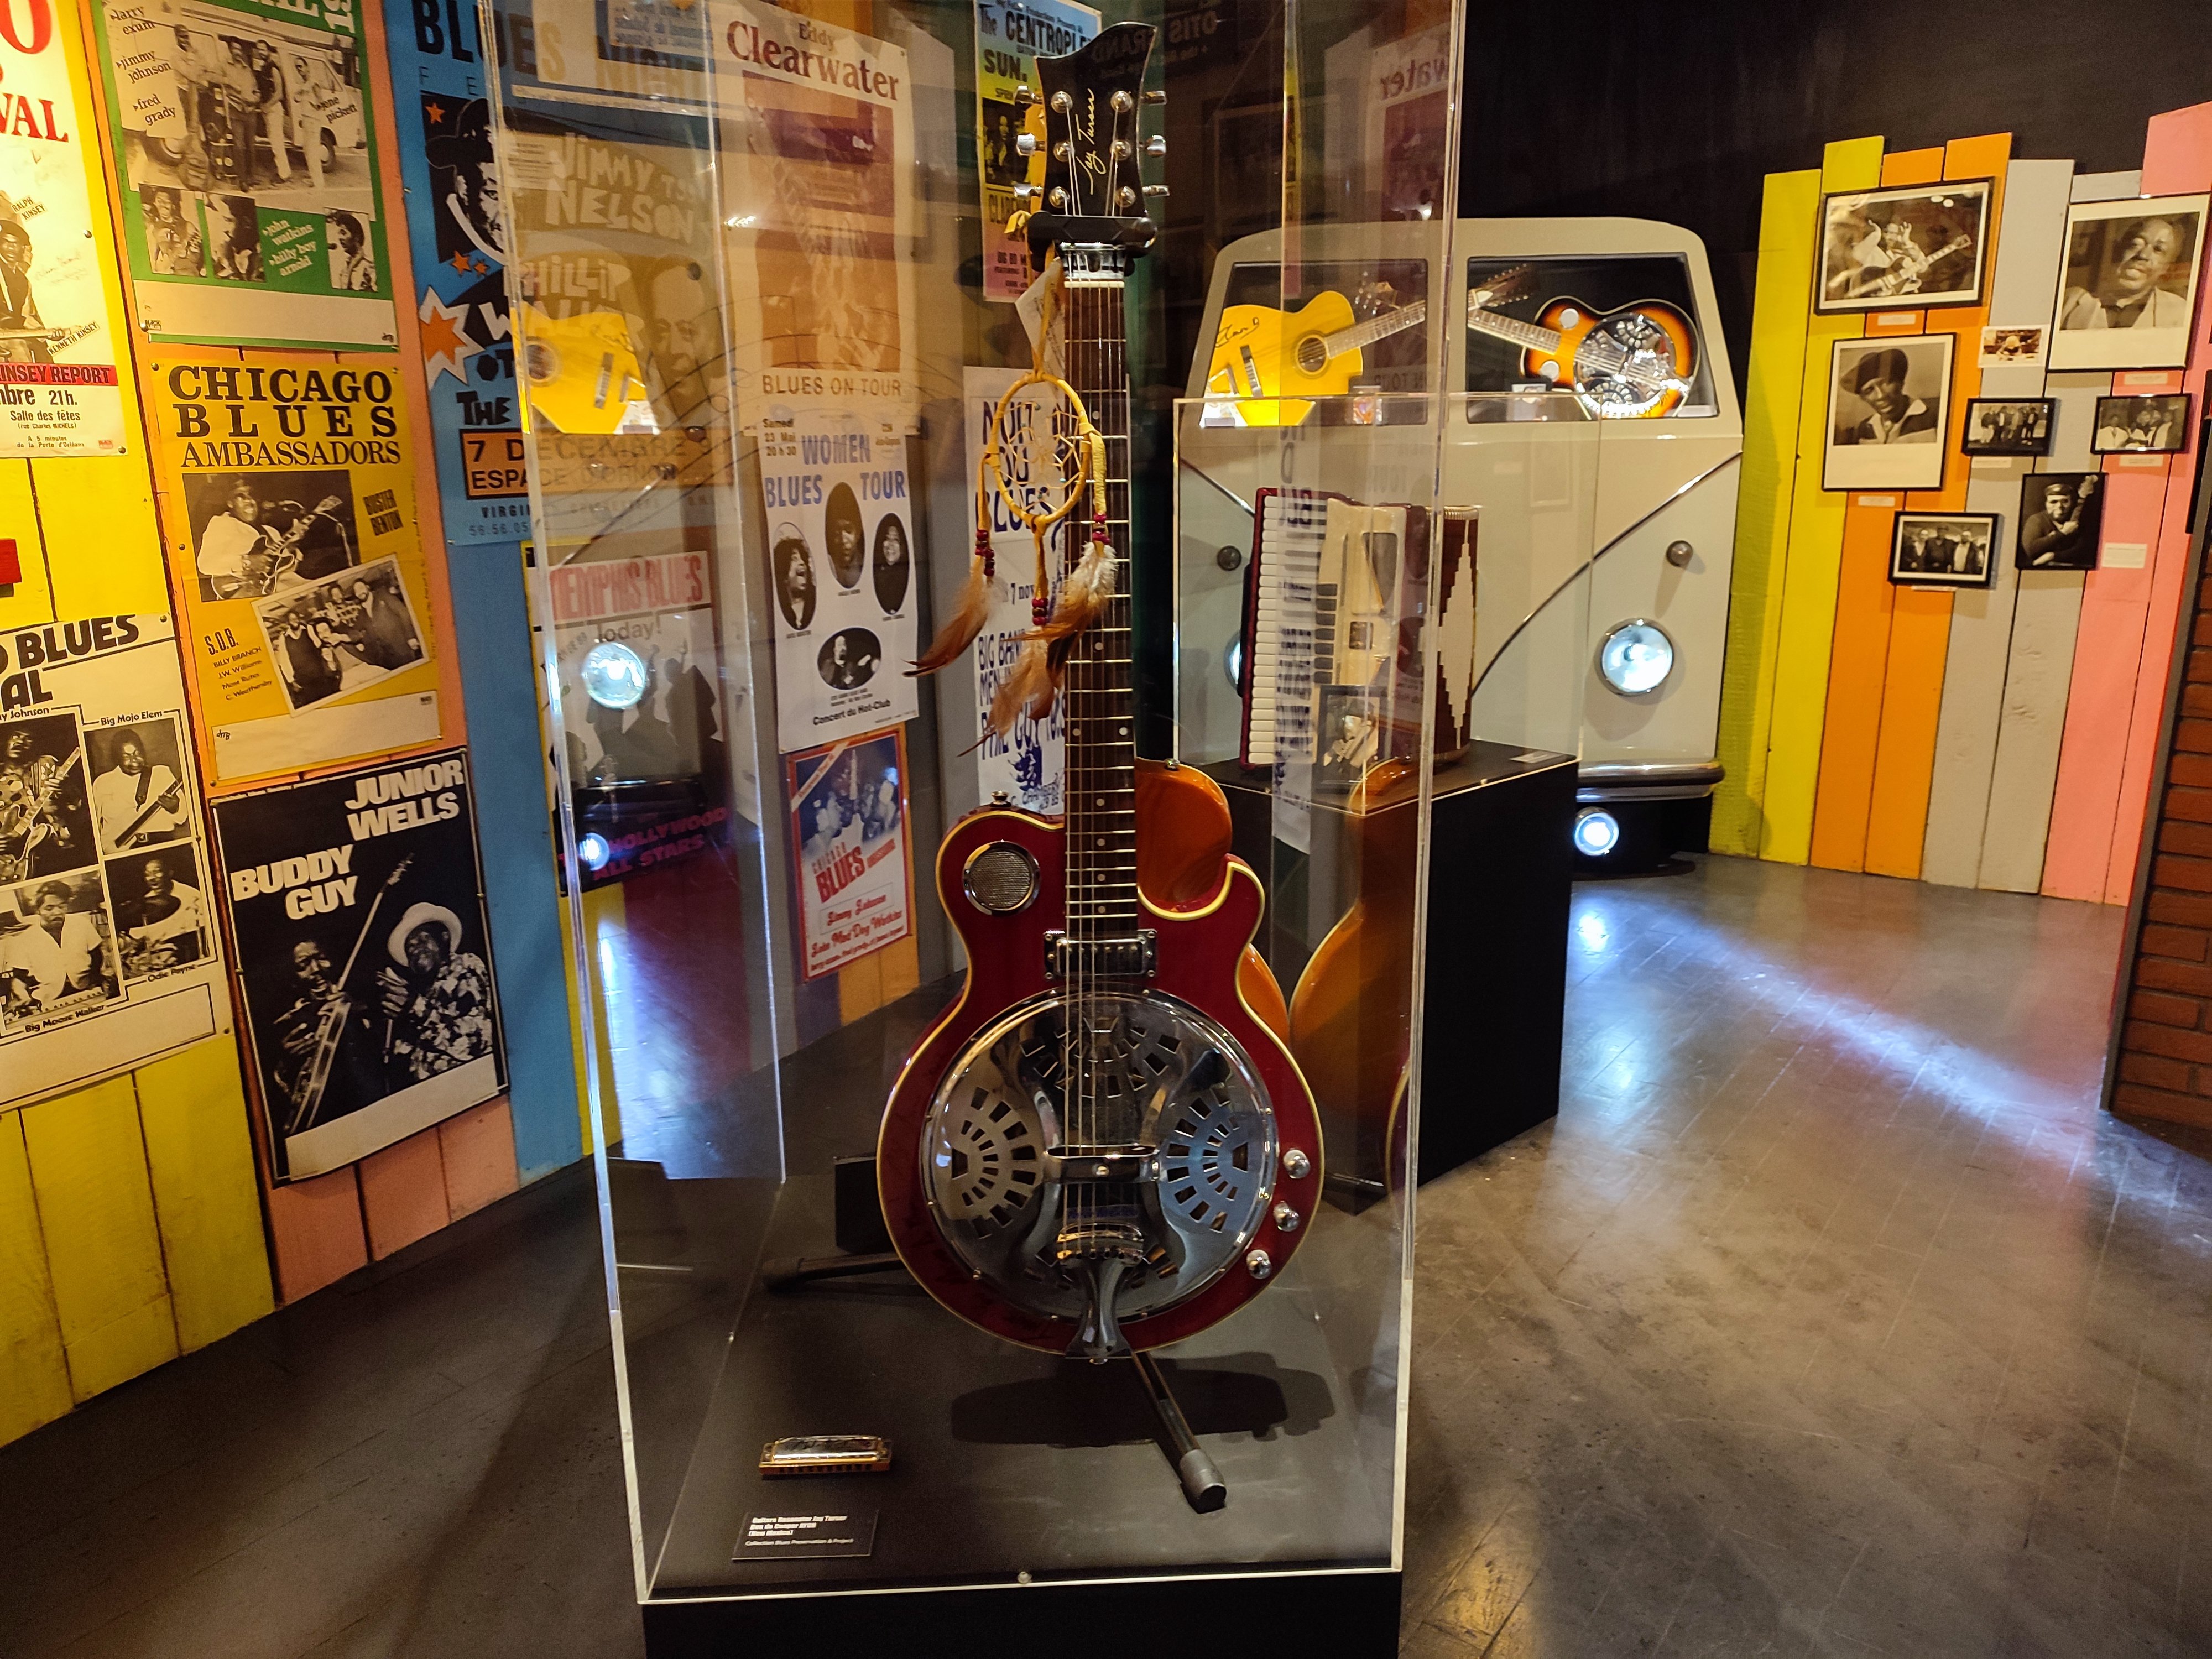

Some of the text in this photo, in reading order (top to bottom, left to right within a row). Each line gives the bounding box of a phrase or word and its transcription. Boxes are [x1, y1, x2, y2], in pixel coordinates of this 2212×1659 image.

[120, 51, 155, 70] jimmy
[128, 62, 171, 84] johnson
[727, 20, 899, 101] Clearwater
[138, 93, 161, 110] fred
[145, 107, 176, 126] grady
[11, 196, 34, 212] RALPH
[21, 204, 45, 221] KINSEY
[76, 322, 98, 339] KINSEY
[50, 366, 109, 384] REPORT
[169, 365, 393, 403] CHICAGO
[763, 375, 902, 397] BLUES ON TOUR
[10, 409, 81, 421] Salle des fêtes
[173, 404, 397, 437] BLUES
[456, 390, 512, 425] THE
[181, 441, 401, 468] AMBASSADORS
[467, 441, 485, 462] 7
[802, 434, 872, 465] WOMEN
[764, 471, 906, 508] BLUES TOUR
[597, 612, 662, 643] Today!
[15, 614, 139, 669] BLUES
[232, 646, 262, 661] BRANCH
[978, 634, 995, 671] BIG
[11, 708, 49, 719] Johnson
[101, 717, 116, 726] Big
[118, 712, 139, 723] Mojo
[142, 711, 163, 719] Elem
[813, 710, 846, 726] Concert
[847, 708, 857, 717] du
[345, 759, 465, 810] JUNIOR
[347, 792, 460, 841] WELLS
[639, 833, 705, 866] STARS
[230, 844, 354, 901] BUDDY
[815, 846, 865, 904] BLUES
[284, 876, 358, 920] GUY
[25, 1024, 40, 1033] Big
